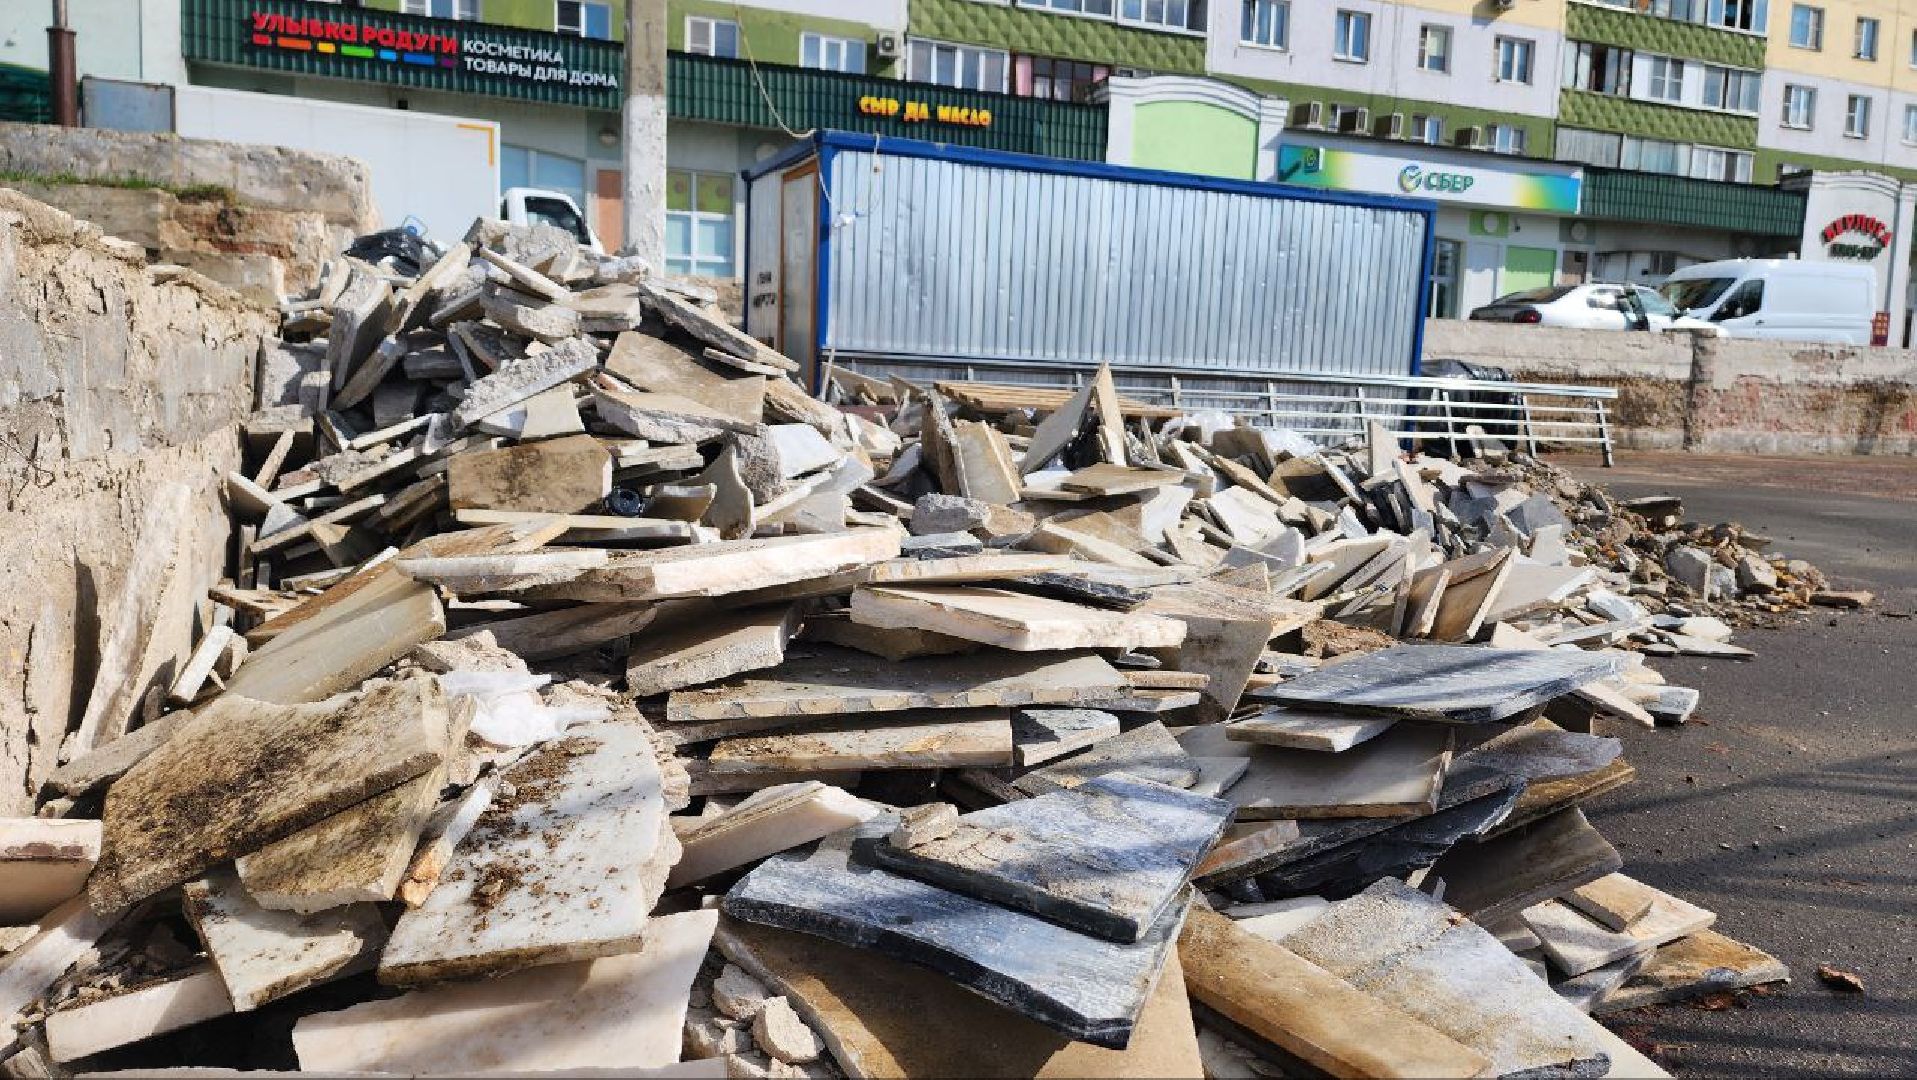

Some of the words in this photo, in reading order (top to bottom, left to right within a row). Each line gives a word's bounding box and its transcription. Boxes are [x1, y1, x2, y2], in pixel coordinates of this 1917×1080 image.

[463, 39, 564, 64] КОСМЕТИКА
[464, 57, 532, 77] ТОВАРЫ
[533, 66, 567, 82] ДЛЯ
[569, 70, 618, 87] ДОМА
[859, 96, 899, 116] СЫР
[903, 102, 929, 122] ДА
[937, 105, 992, 127] МАСЛО
[1426, 172, 1474, 193] СБЕР
